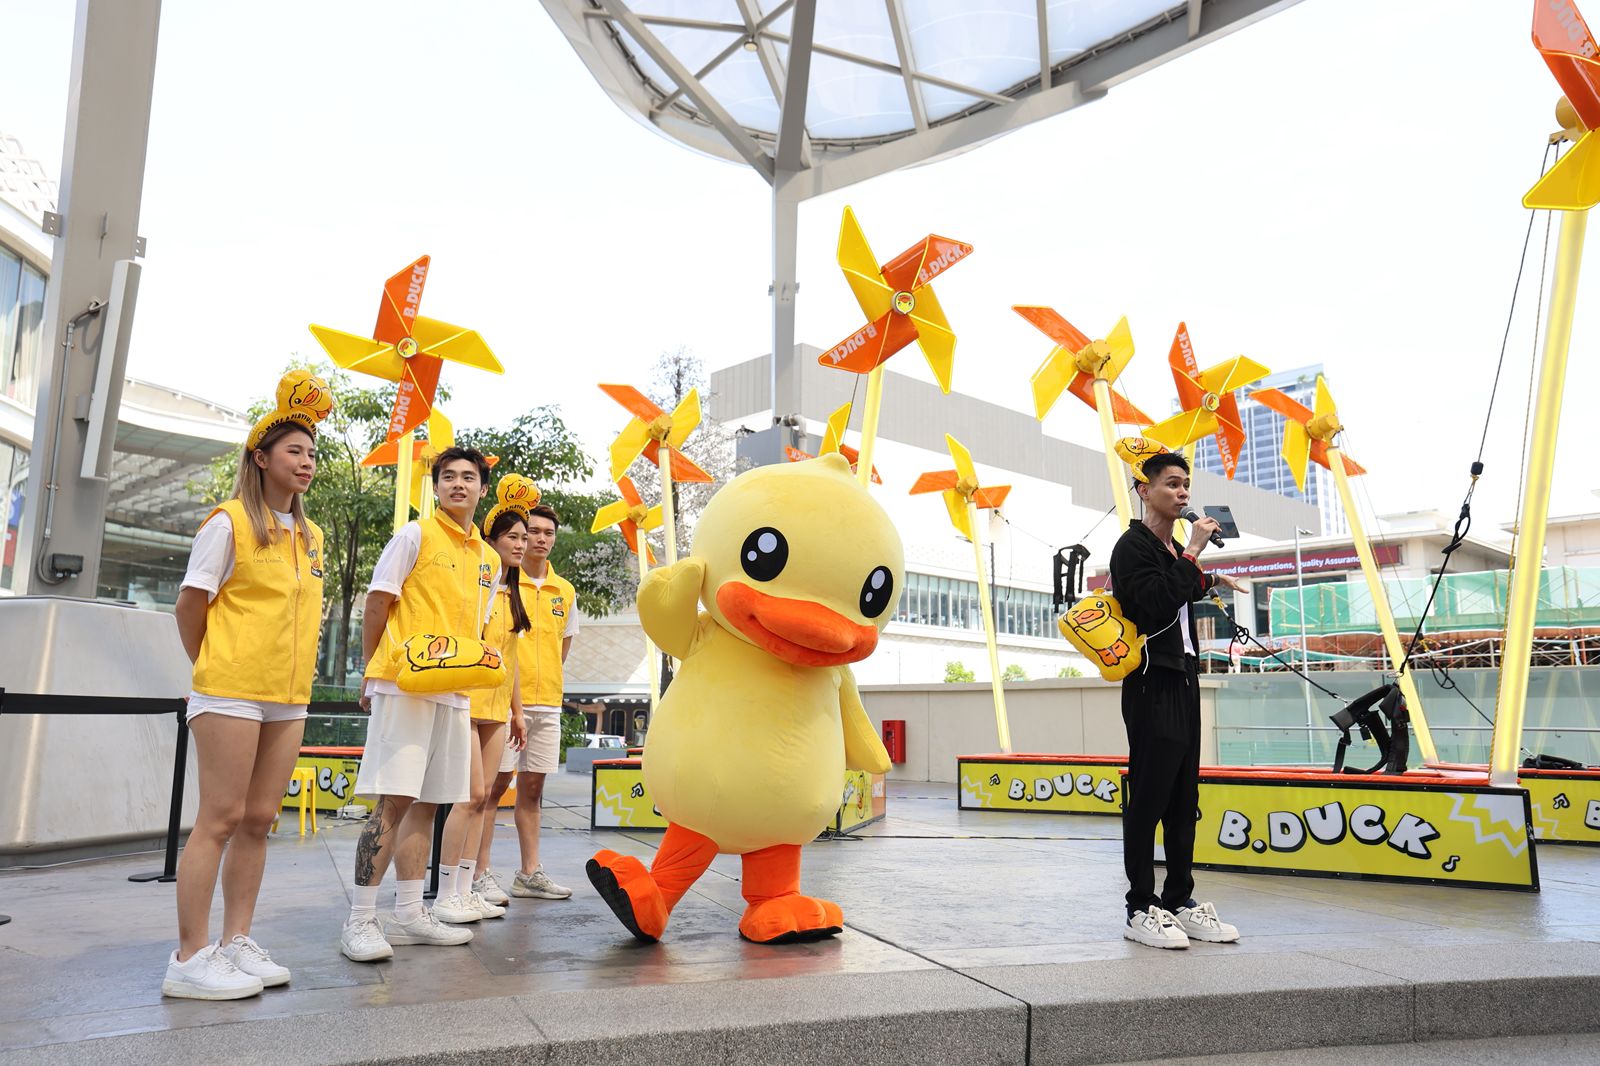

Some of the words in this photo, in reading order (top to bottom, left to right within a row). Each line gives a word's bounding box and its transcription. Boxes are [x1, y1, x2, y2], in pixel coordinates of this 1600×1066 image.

[917, 244, 965, 283] B.DUCK
[403, 264, 426, 319] B.DUCK
[829, 325, 878, 365] B.DUCK
[1178, 331, 1199, 378] B.DUCK
[391, 381, 415, 434] B.DUCK
[1216, 565, 1237, 575] Brand
[1238, 564, 1248, 573] for
[1248, 562, 1295, 573] Generations,
[1300, 558, 1324, 568] uality
[1008, 772, 1119, 803] B.DUCK
[1217, 800, 1441, 860] B.DUCK
